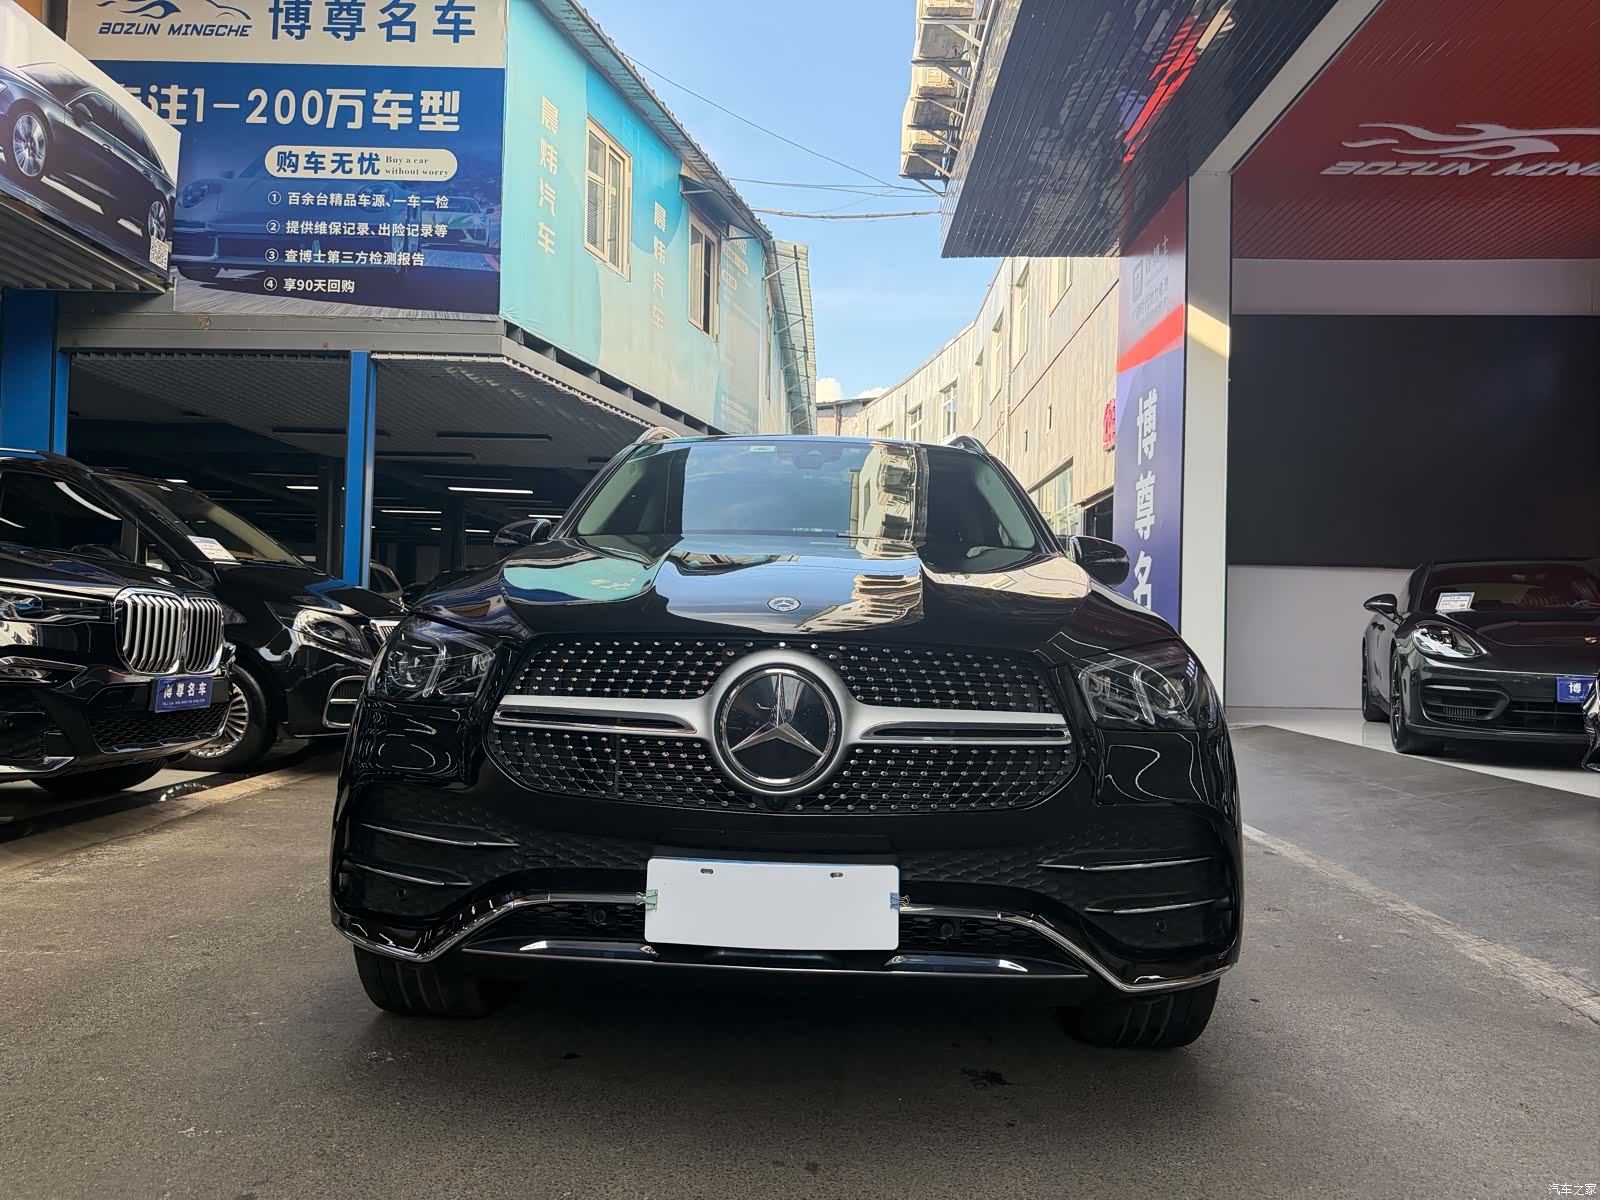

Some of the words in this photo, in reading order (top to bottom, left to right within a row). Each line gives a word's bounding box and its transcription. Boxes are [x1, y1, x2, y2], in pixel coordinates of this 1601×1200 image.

[98, 22, 161, 36] BOZUN
[167, 23, 252, 37] MINGCHE
[268, 0, 476, 44] 博尊名车
[276, 150, 381, 176] 购车无忧
[385, 155, 403, 166] Buy
[1320, 160, 1491, 176] BOZUN
[385, 167, 419, 176] without
[422, 169, 449, 178] worry
[284, 249, 425, 267] 查博士第三方检测报告
[283, 278, 356, 293] 享90天回购
